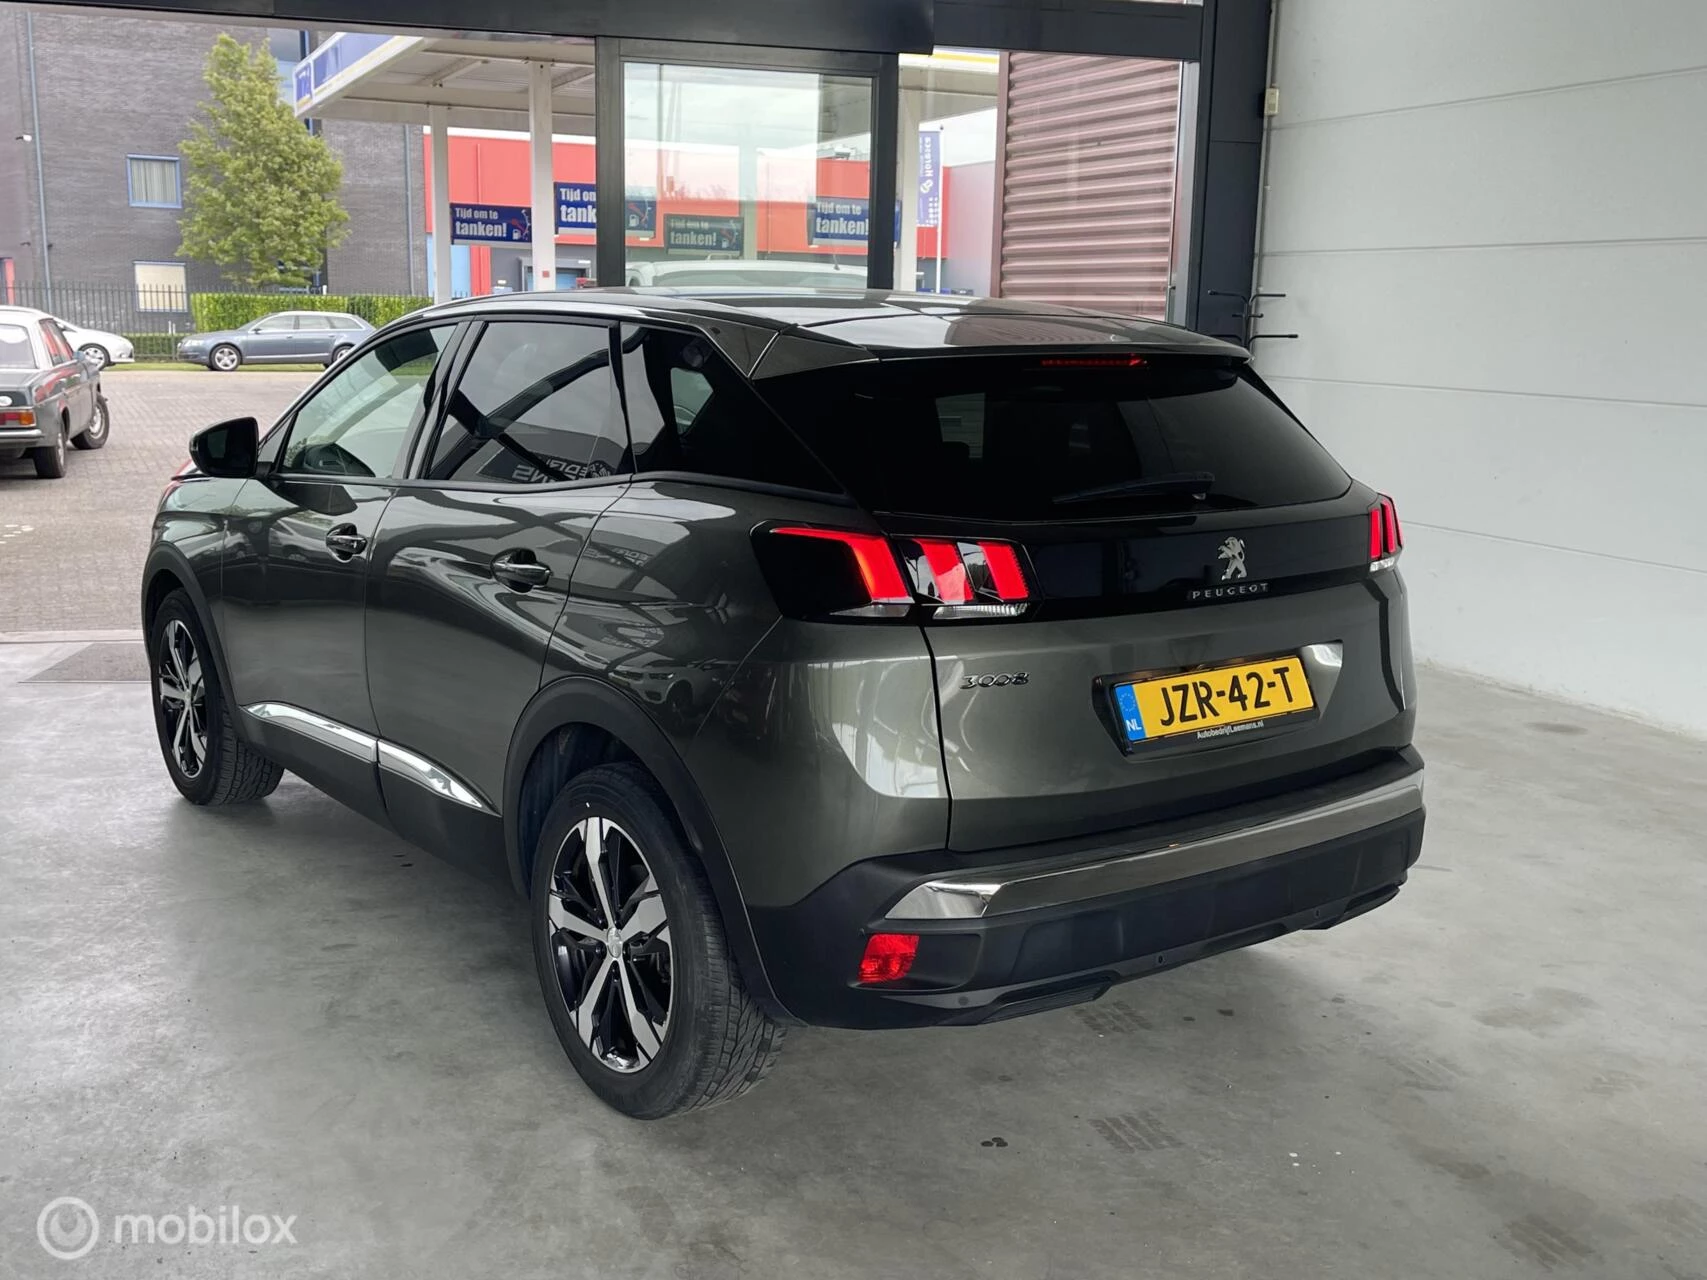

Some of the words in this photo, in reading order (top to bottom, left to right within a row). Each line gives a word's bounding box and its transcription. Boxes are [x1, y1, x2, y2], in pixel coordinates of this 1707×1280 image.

[560, 188, 580, 202] Tijd
[455, 207, 472, 219] Tijd
[473, 211, 488, 219] om
[488, 210, 498, 219] te
[816, 201, 834, 214] Tijd
[852, 204, 862, 215] te
[456, 221, 507, 237] tanken!
[816, 217, 869, 236] tanken!
[670, 231, 716, 246] tanken!
[1192, 583, 1268, 599] PEUGEOT
[960, 671, 1029, 690] 3008
[1160, 666, 1293, 727] JZR-42-T
[1125, 718, 1143, 732] NL
